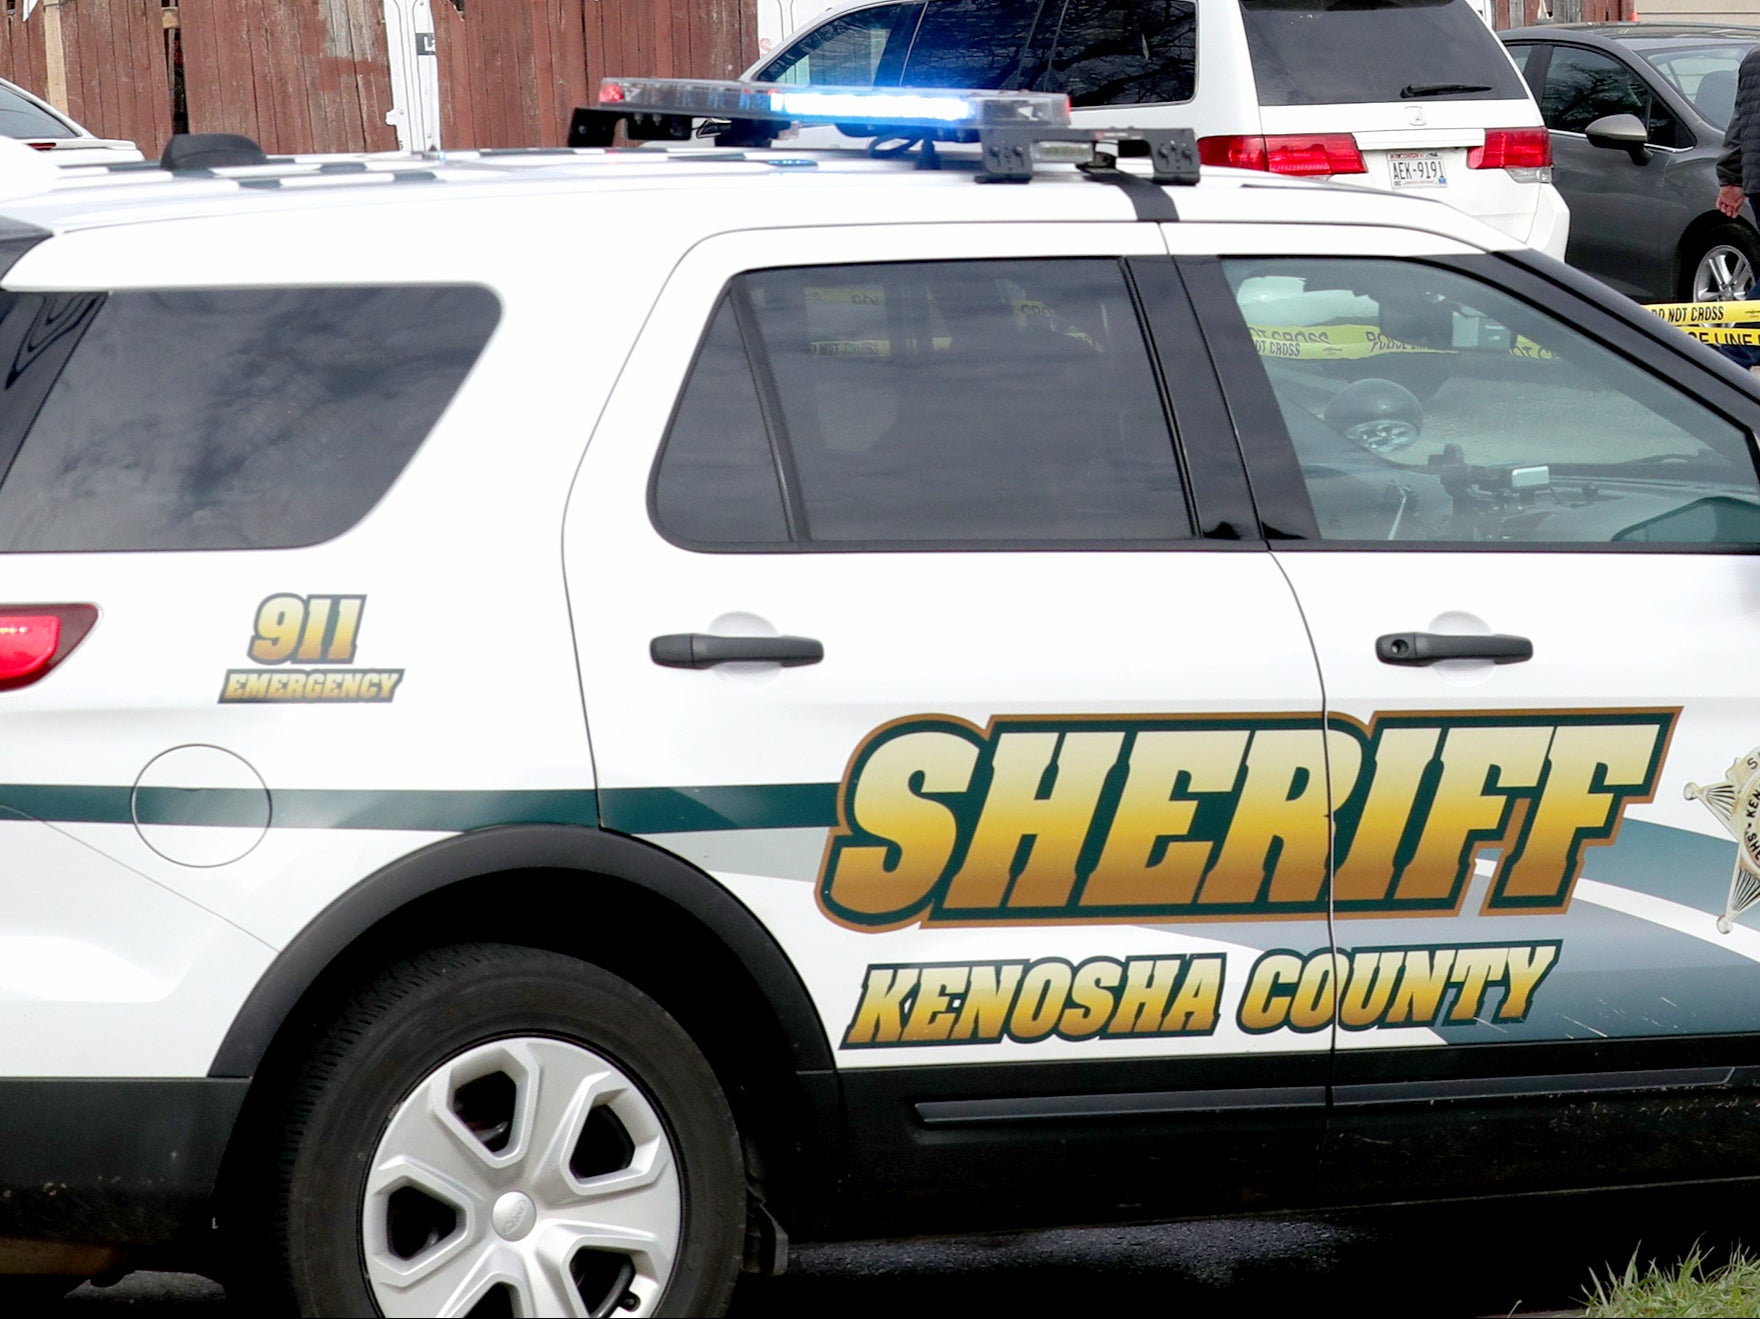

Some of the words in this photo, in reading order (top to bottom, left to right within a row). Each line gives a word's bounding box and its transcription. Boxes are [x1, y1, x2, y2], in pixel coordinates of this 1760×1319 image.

[1393, 161, 1444, 180] AEK-9191
[1668, 308, 1687, 323] NOT
[1691, 306, 1724, 321] CROSS
[1269, 341, 1301, 357] CROSS
[247, 592, 367, 665] 911
[217, 668, 405, 704] EMERGENCY
[814, 707, 1684, 933] SHERIFF
[840, 953, 1227, 1050] KENOSHA
[1236, 940, 1563, 1035] COUNTY
